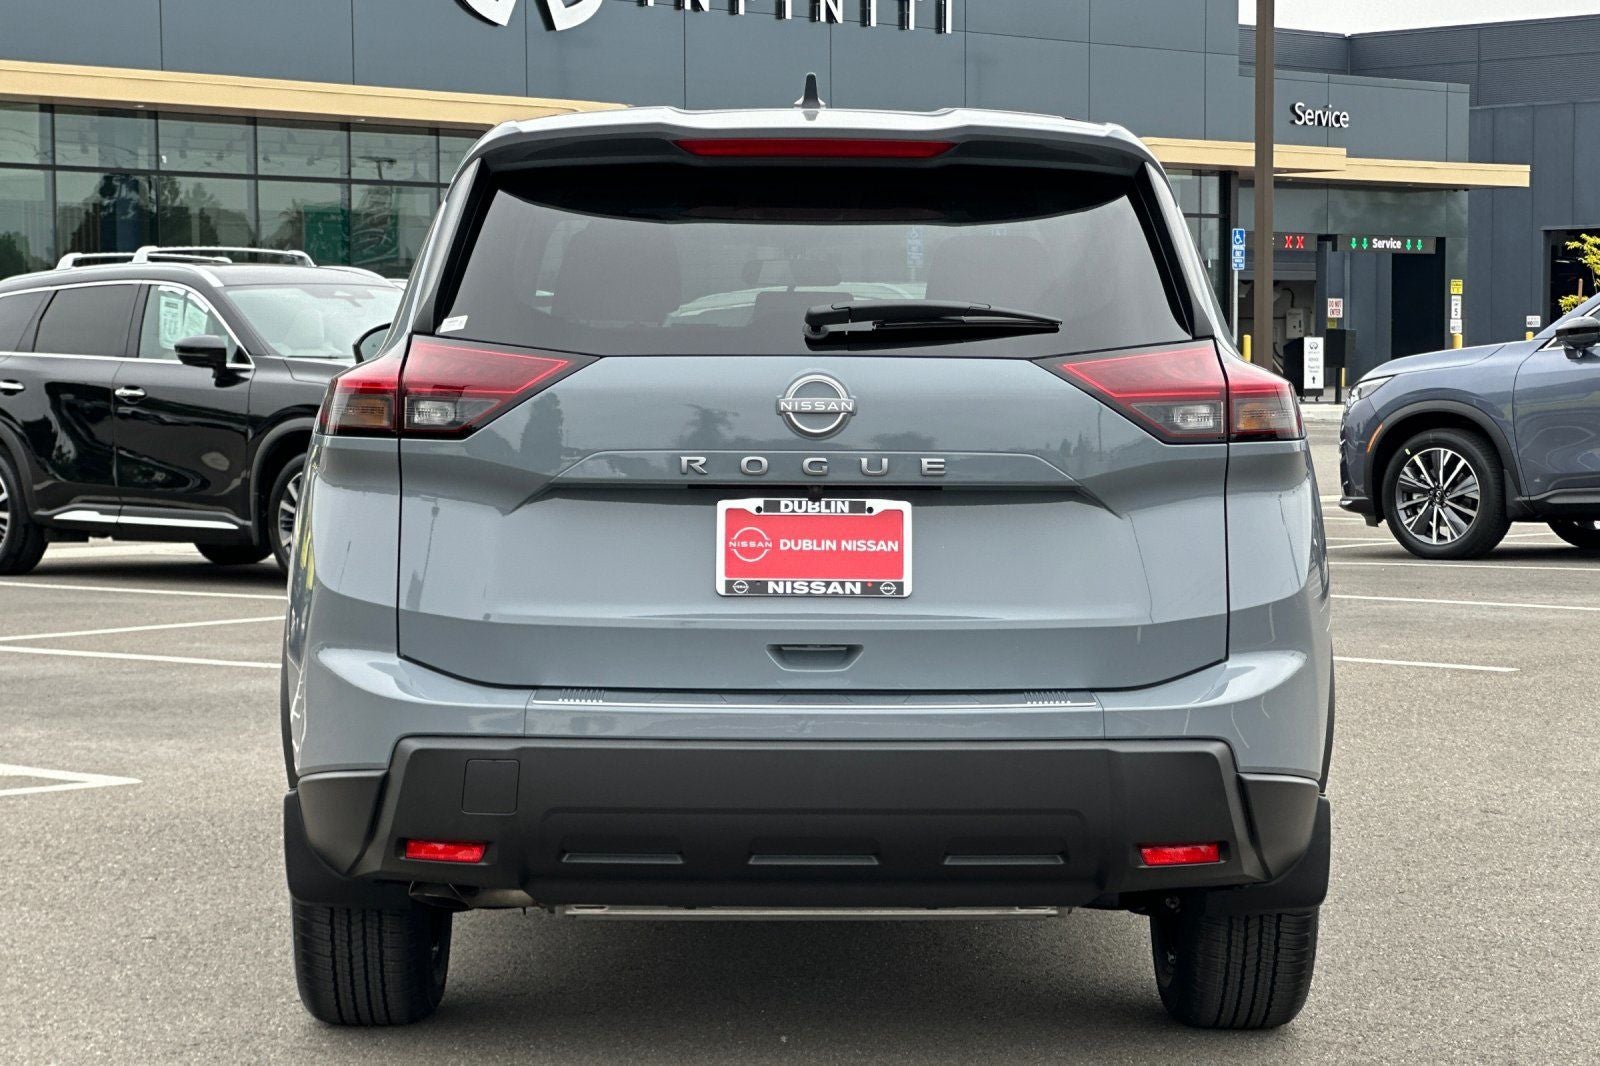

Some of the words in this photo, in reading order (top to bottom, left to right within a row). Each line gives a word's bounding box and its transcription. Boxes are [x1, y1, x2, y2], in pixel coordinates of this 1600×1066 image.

[1294, 102, 1350, 128] Service
[1372, 237, 1402, 249] Service
[780, 400, 854, 411] NISSAN
[680, 456, 946, 476] ROGUE
[780, 500, 849, 513] DUBLIN
[779, 539, 836, 551] DUBLIN
[841, 540, 898, 552] NISSAN
[767, 581, 861, 595] NISSAN
